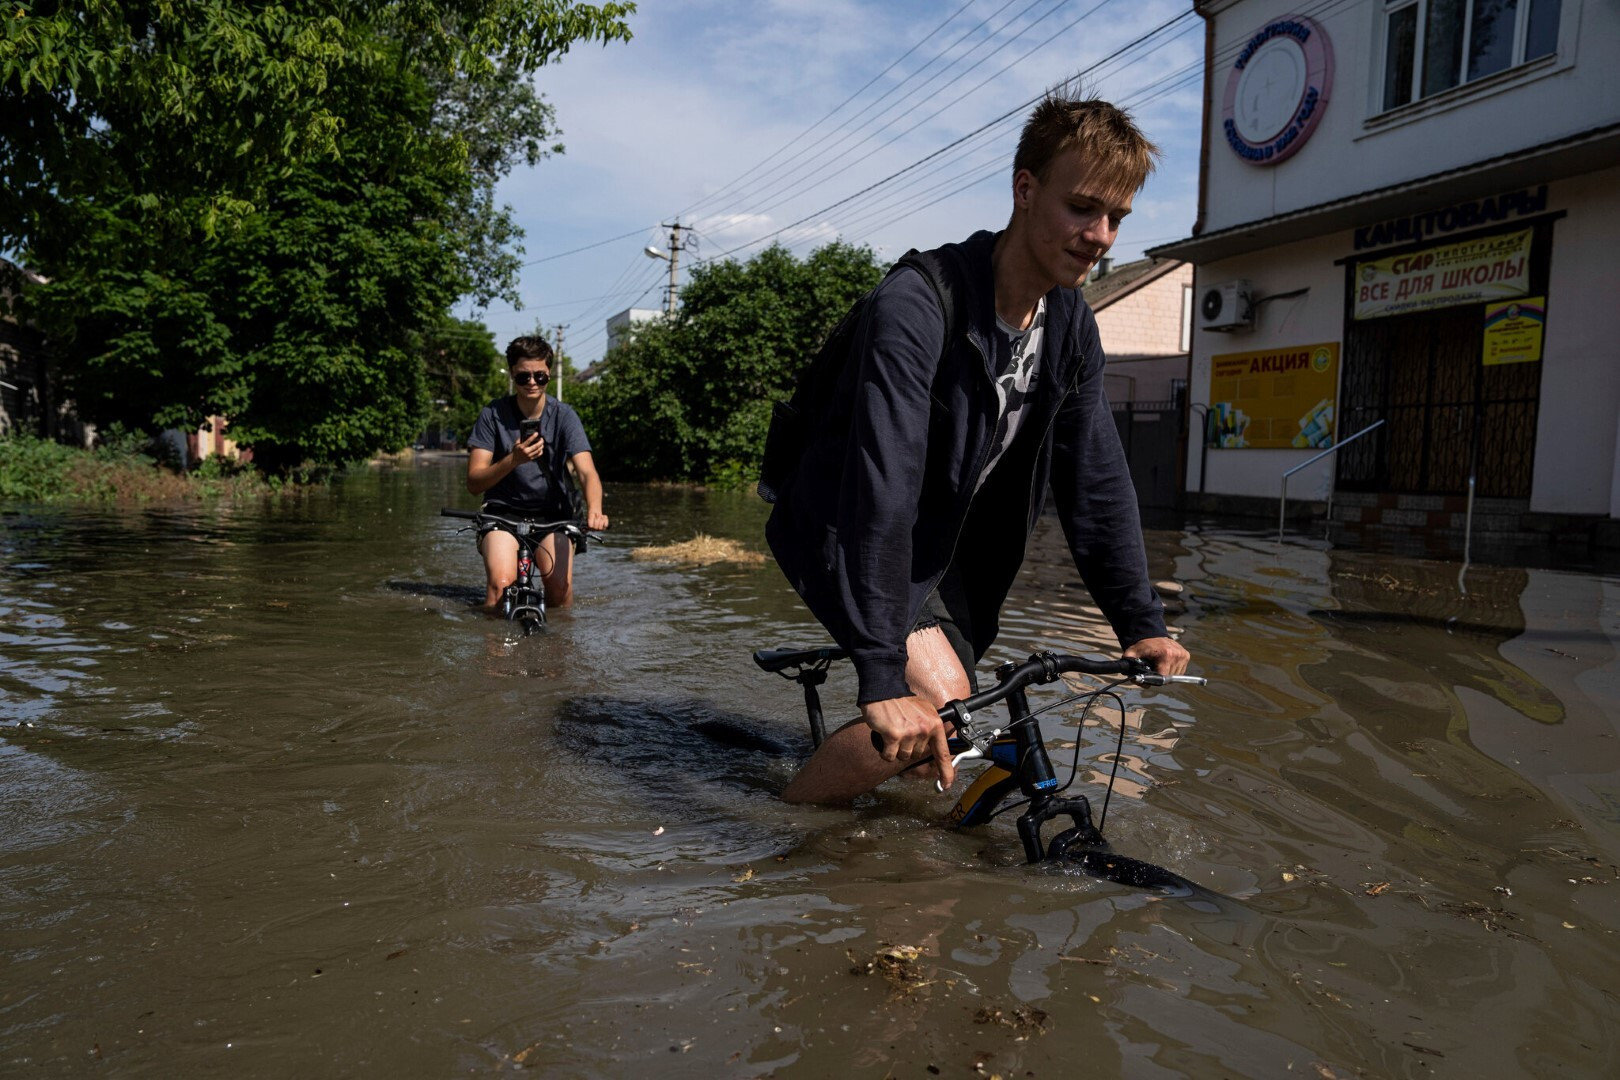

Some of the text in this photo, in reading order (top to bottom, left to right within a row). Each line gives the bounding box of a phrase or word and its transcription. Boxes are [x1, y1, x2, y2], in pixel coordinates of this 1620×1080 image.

[1354, 185, 1549, 250] КАНЦТОВАРЫ
[1359, 257, 1526, 303] ВСЕ ДЛЯ ШКОЛЫ
[1391, 253, 1435, 275] СТАР
[1250, 352, 1310, 373] АКЦИЯ
